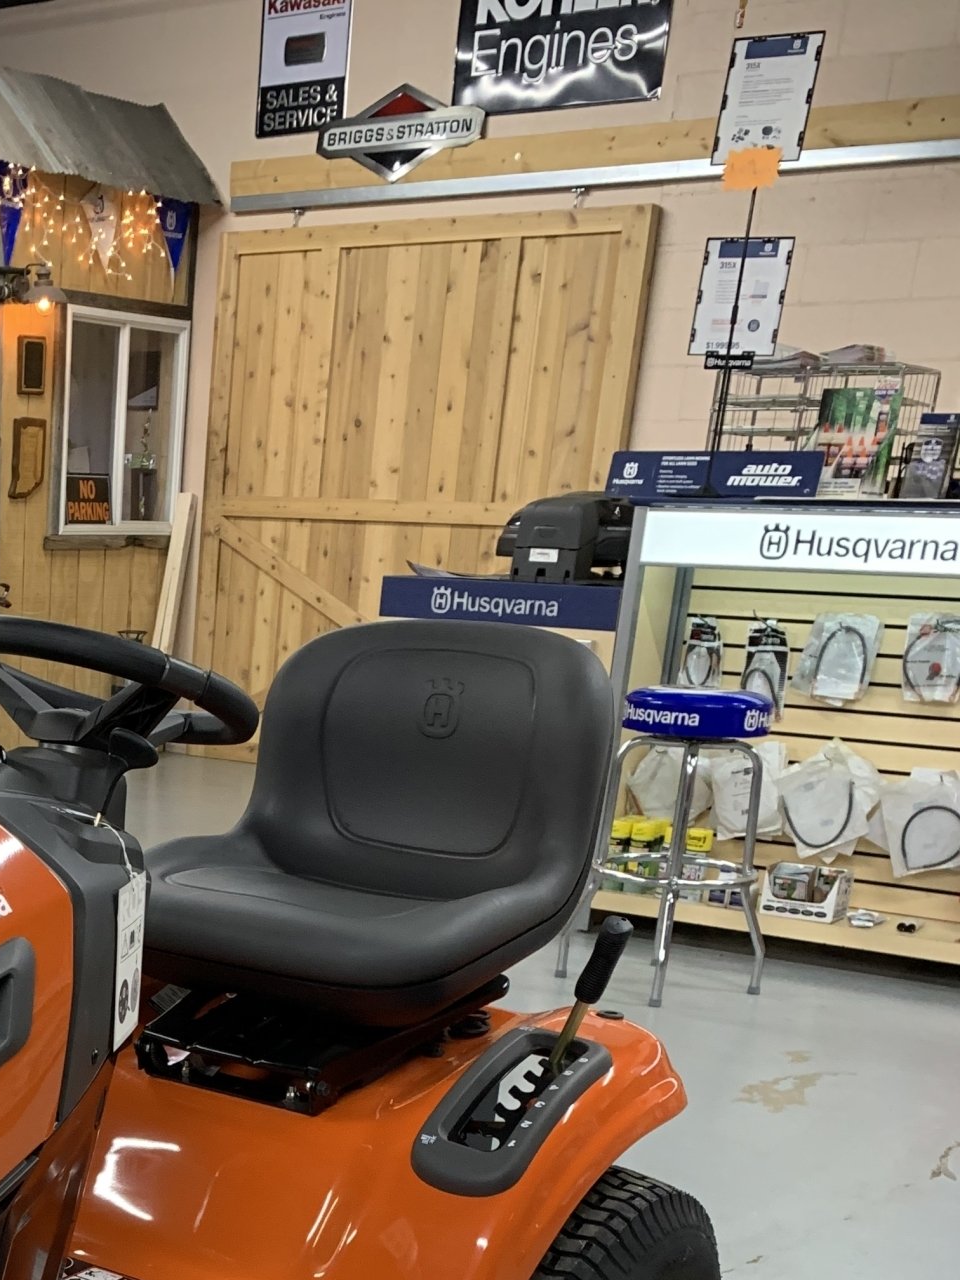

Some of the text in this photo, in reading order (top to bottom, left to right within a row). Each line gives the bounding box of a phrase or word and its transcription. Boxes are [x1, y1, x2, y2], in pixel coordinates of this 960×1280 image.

[470, 20, 640, 85] Engines
[266, 83, 338, 110] SALES &
[327, 127, 385, 147] BRIGGS
[396, 117, 473, 140] STRATTON
[742, 463, 792, 475] auto
[80, 480, 96, 499] NO
[68, 501, 109, 521] PARKING
[793, 529, 959, 564] Husqvarna
[453, 591, 559, 617] Husqvarna
[626, 703, 700, 726] Husqvarna
